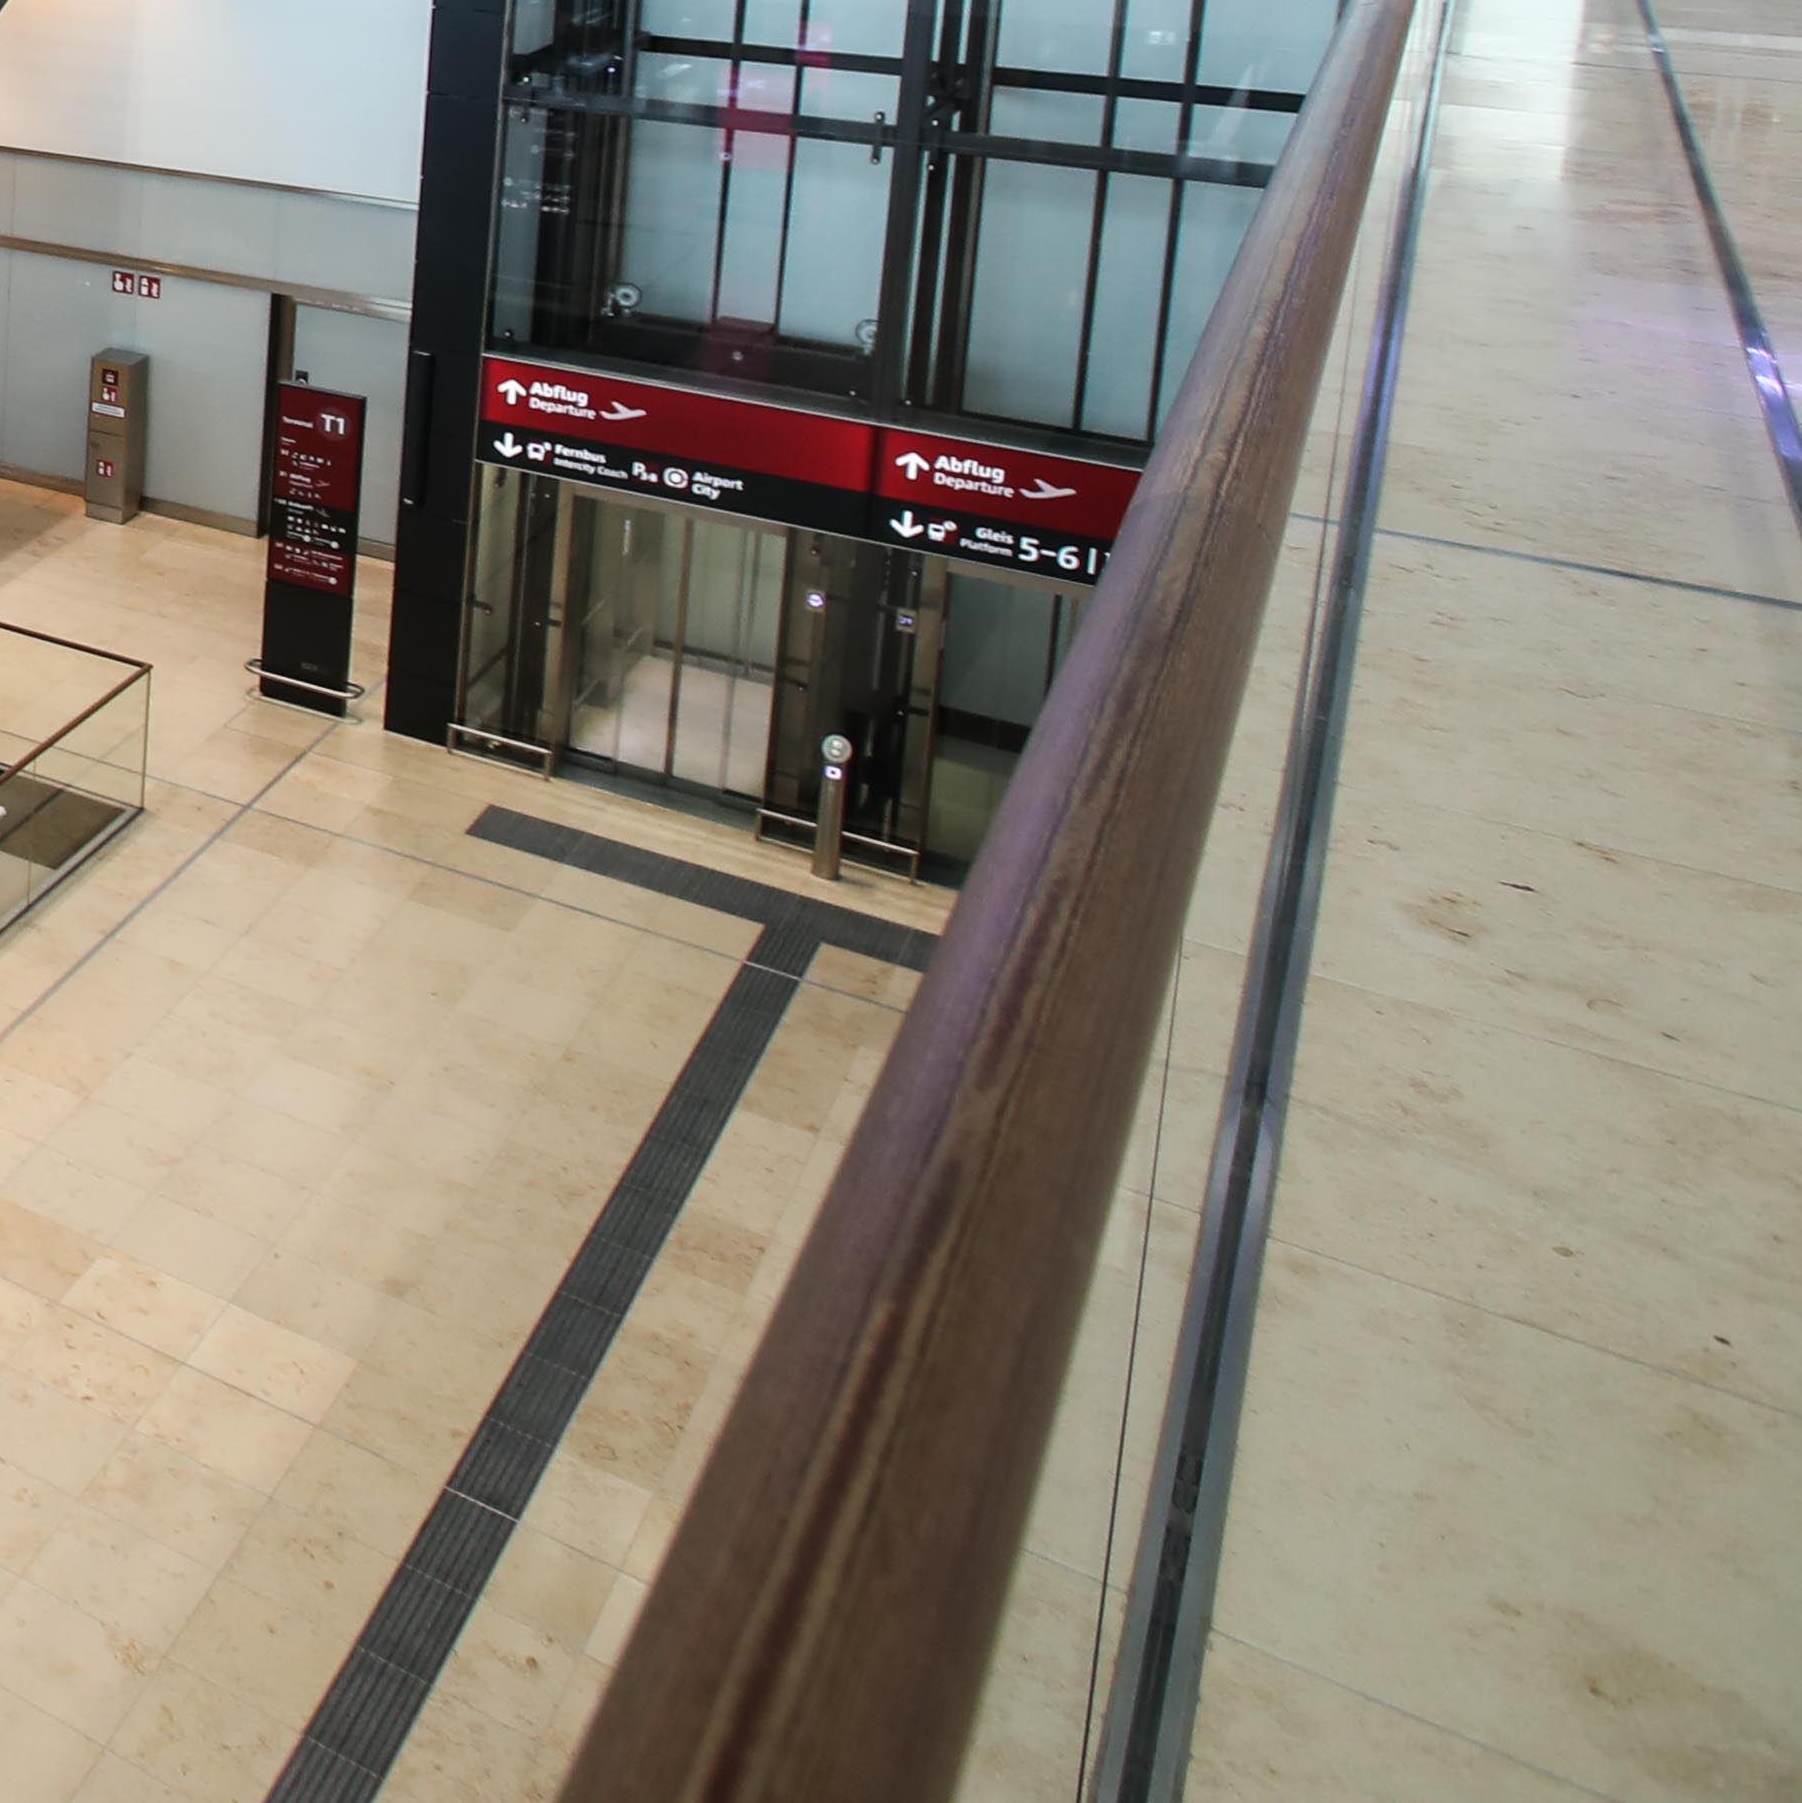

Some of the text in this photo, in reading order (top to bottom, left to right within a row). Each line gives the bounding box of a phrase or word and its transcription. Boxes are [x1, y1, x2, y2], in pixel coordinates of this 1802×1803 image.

[529, 381, 589, 407] Abflug
[529, 397, 597, 420] Departure
[320, 413, 346, 435] T1
[554, 444, 607, 464] Fernbus
[553, 457, 629, 479] Intercity Coach
[934, 454, 1006, 484] Abflug
[691, 483, 721, 501] City
[692, 471, 744, 491] Airport
[932, 471, 1015, 499] Departure
[974, 526, 1015, 545] Gleis
[958, 538, 1014, 558] Platform
